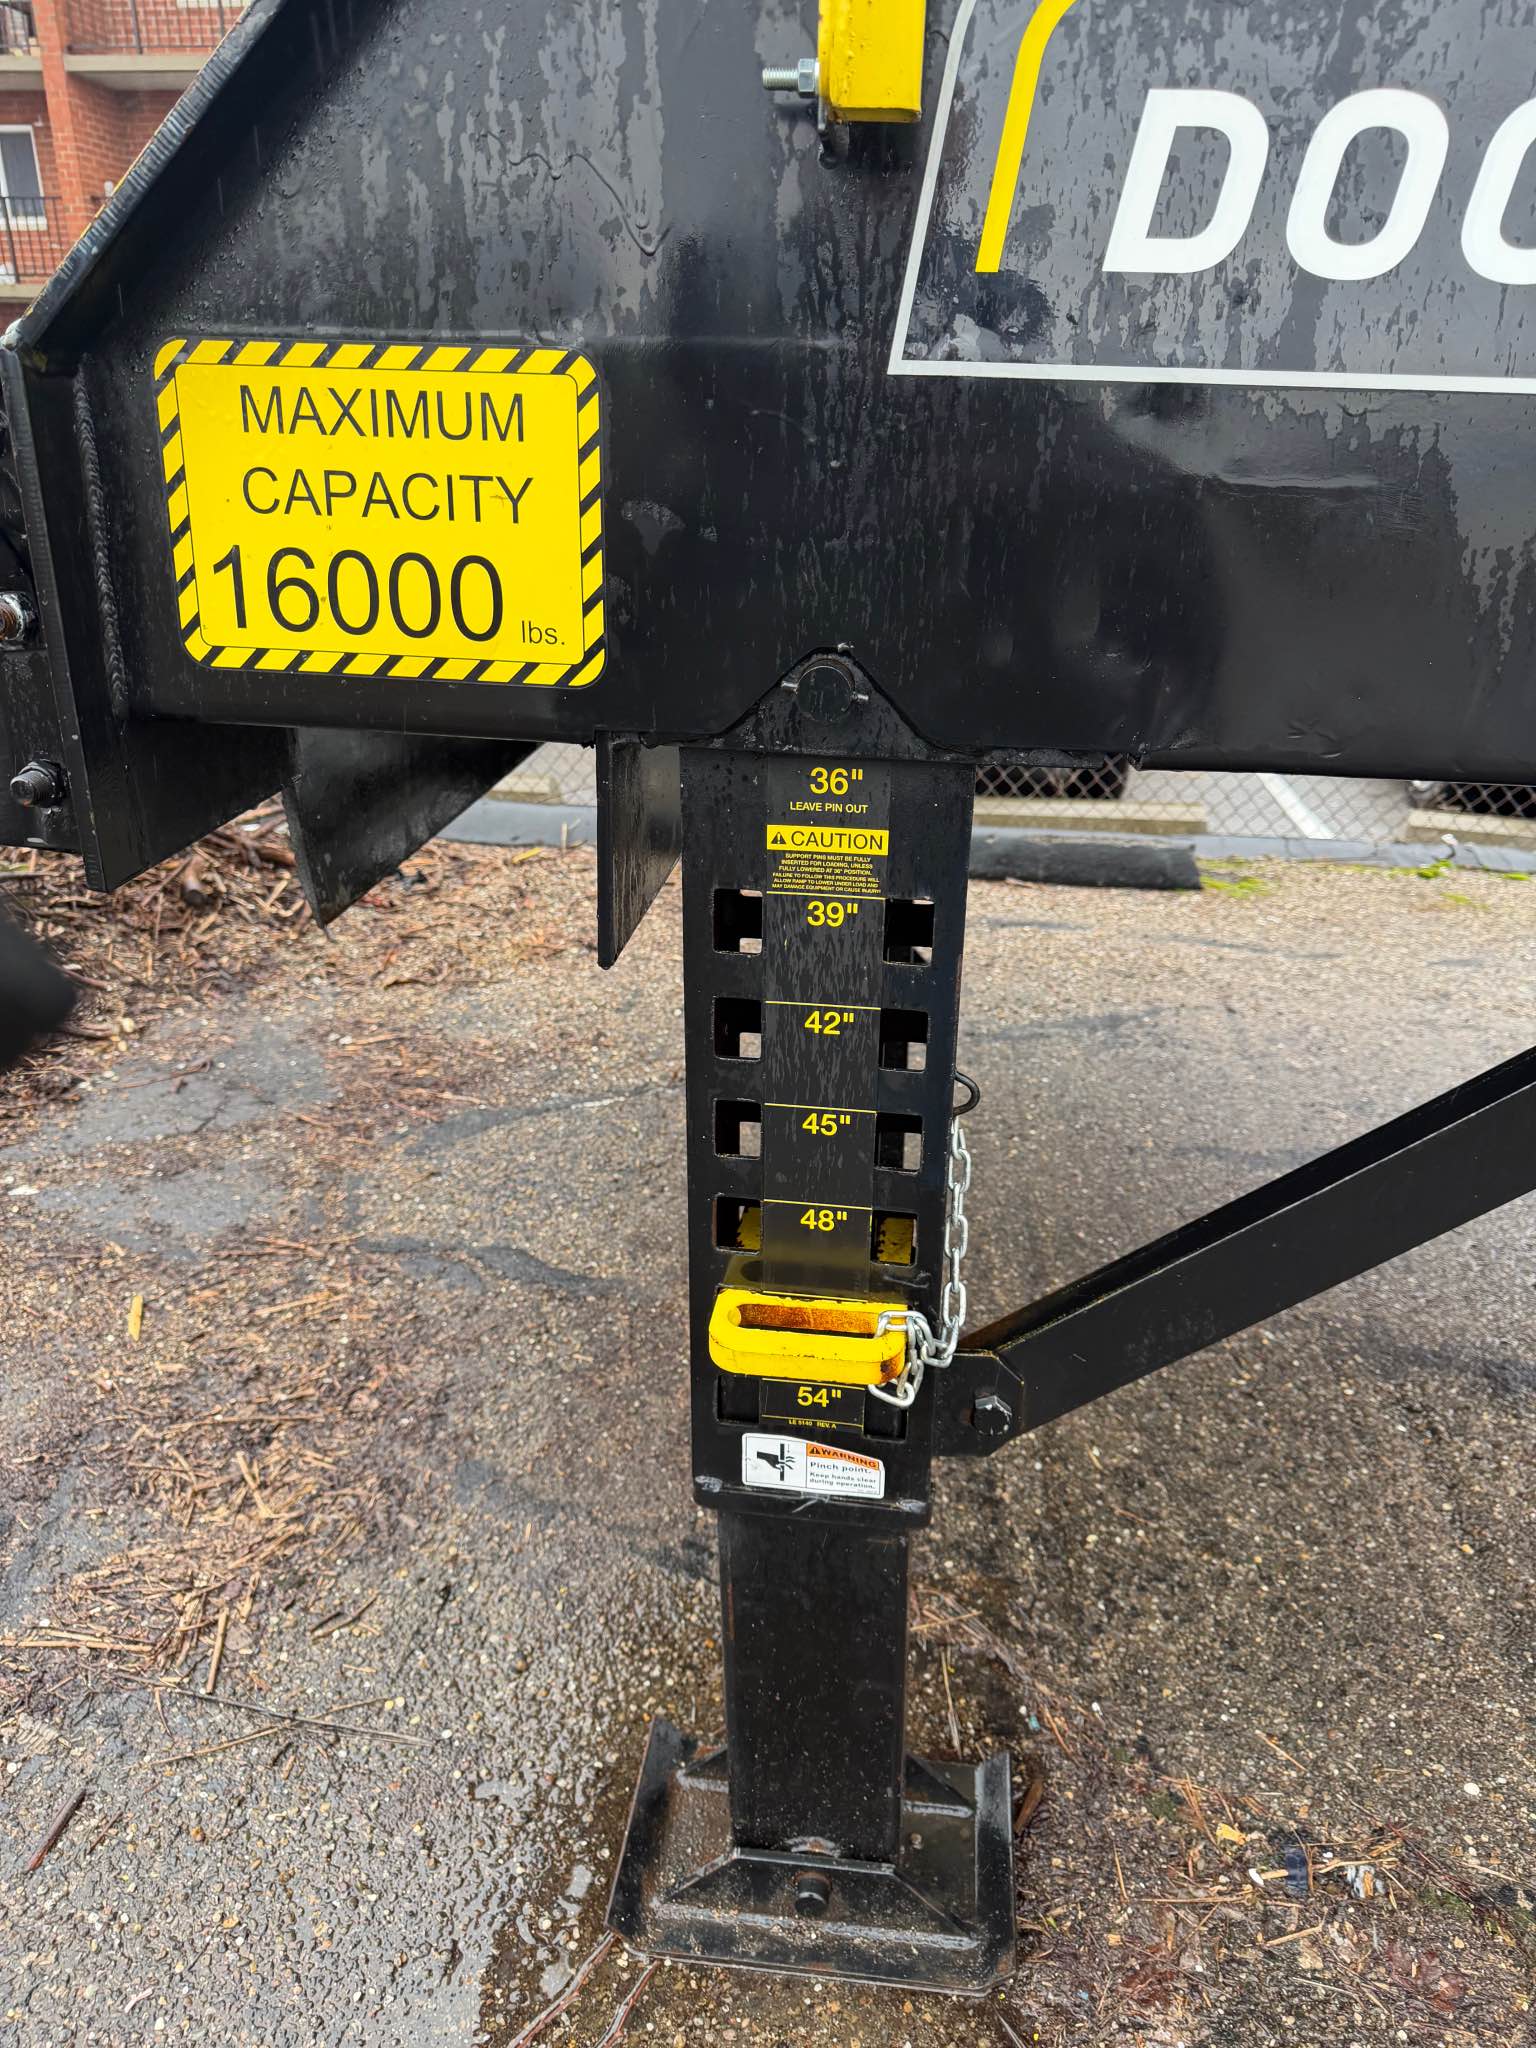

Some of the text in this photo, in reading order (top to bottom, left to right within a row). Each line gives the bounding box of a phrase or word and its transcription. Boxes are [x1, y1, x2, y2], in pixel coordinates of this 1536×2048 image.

[239, 384, 525, 442] MAXIMUM
[242, 467, 533, 524] CAPACITY
[212, 544, 565, 646] 16000 lbs.
[809, 767, 864, 795] 36"
[790, 801, 869, 814] LEAVE PIN OUT
[791, 830, 883, 850] CAUTION
[807, 901, 858, 928] 39"
[804, 1010, 854, 1035] 42"
[802, 1112, 851, 1136] 45"
[800, 1209, 848, 1232] 48"
[797, 1386, 842, 1408] 54"
[810, 1461, 872, 1474] Pinch point.
[822, 1448, 877, 1468] WARNING
[810, 1478, 834, 1486] during
